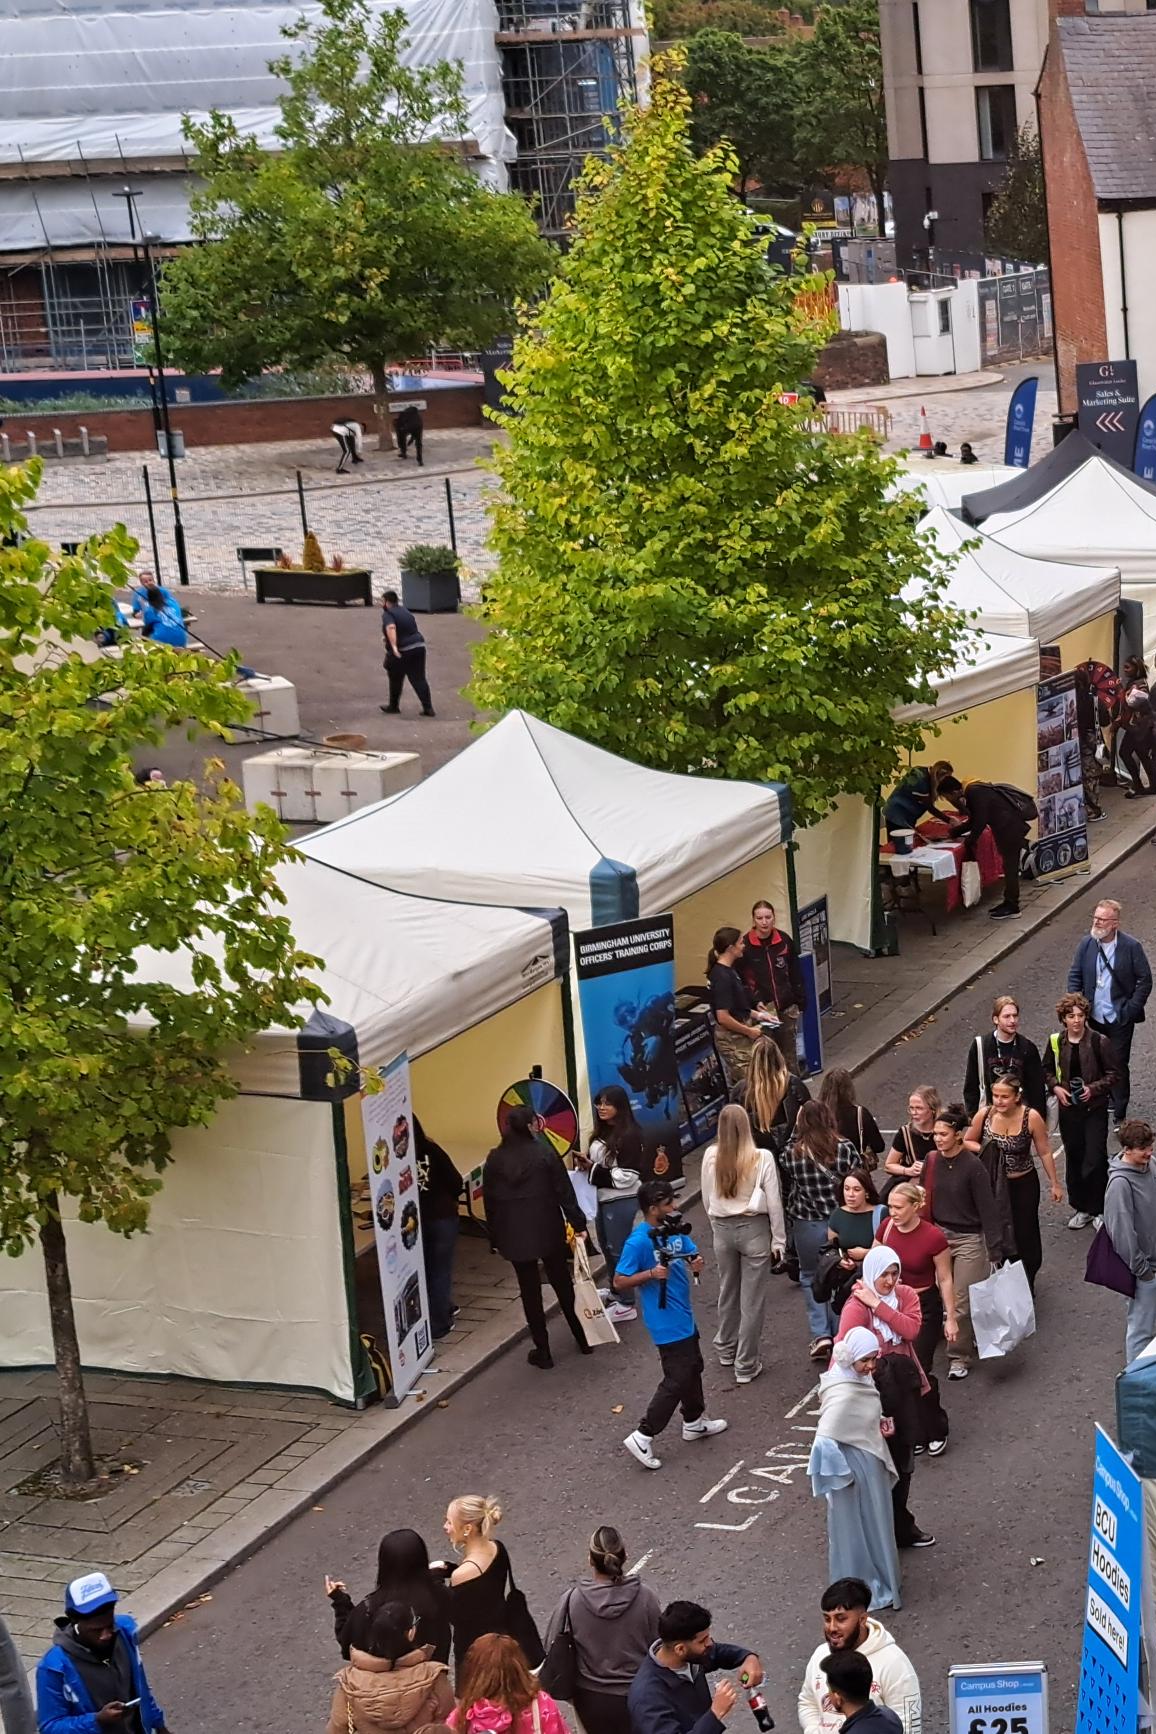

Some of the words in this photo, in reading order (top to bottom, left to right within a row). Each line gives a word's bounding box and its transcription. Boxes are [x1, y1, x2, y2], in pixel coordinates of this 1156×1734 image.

[1082, 398, 1118, 407] Marketing
[1118, 396, 1136, 404] Suite
[1095, 390, 1114, 398] Sales
[1114, 389, 1122, 397] &
[580, 936, 629, 954] BIRMINGHAM
[629, 928, 671, 944] UNIVERSITY
[580, 952, 613, 966] OFFICERS'
[615, 944, 649, 959] TRAINING
[649, 939, 672, 951] CORPS
[1095, 1455, 1117, 1493] Campus
[1115, 1480, 1130, 1512] Shop
[1095, 1503, 1116, 1542] BCU
[1092, 1541, 1129, 1602] Hoodies
[1090, 1598, 1107, 1629] Sold
[1107, 1616, 1125, 1653] here!
[960, 1681, 996, 1691] Campus
[996, 1680, 1020, 1689] Shop
[968, 1705, 982, 1714] All
[983, 1702, 1027, 1713] Hoodies
[968, 1717, 1029, 1734] £25
